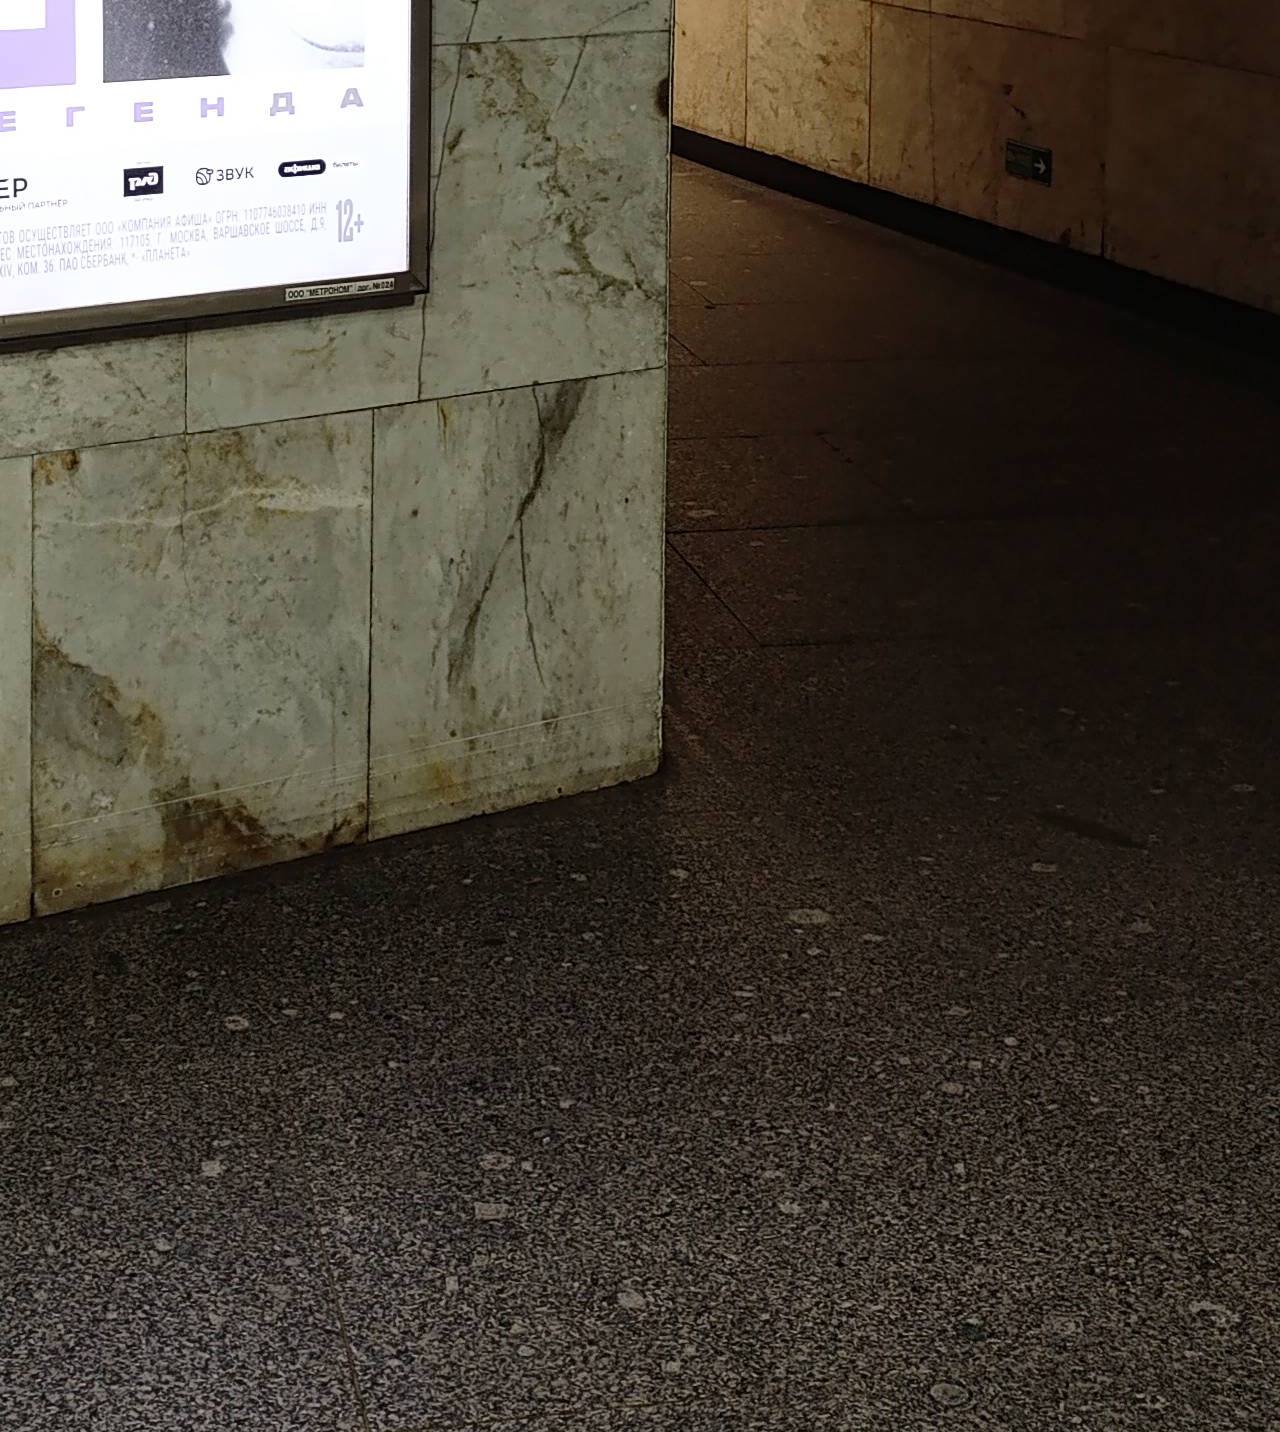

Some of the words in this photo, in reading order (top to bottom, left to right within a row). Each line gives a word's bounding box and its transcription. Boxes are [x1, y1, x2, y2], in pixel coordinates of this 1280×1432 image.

[217, 167, 255, 182] ЗВУК
[18, 222, 92, 243] ОСУЩЕСТВЛЯЕТ
[95, 221, 114, 235] ООО
[308, 201, 327, 215] ИНН
[336, 198, 365, 243] 12+
[213, 220, 270, 240] ВАРШАВСКОЕ
[59, 257, 78, 272] ПАО
[288, 290, 305, 299] ООО
